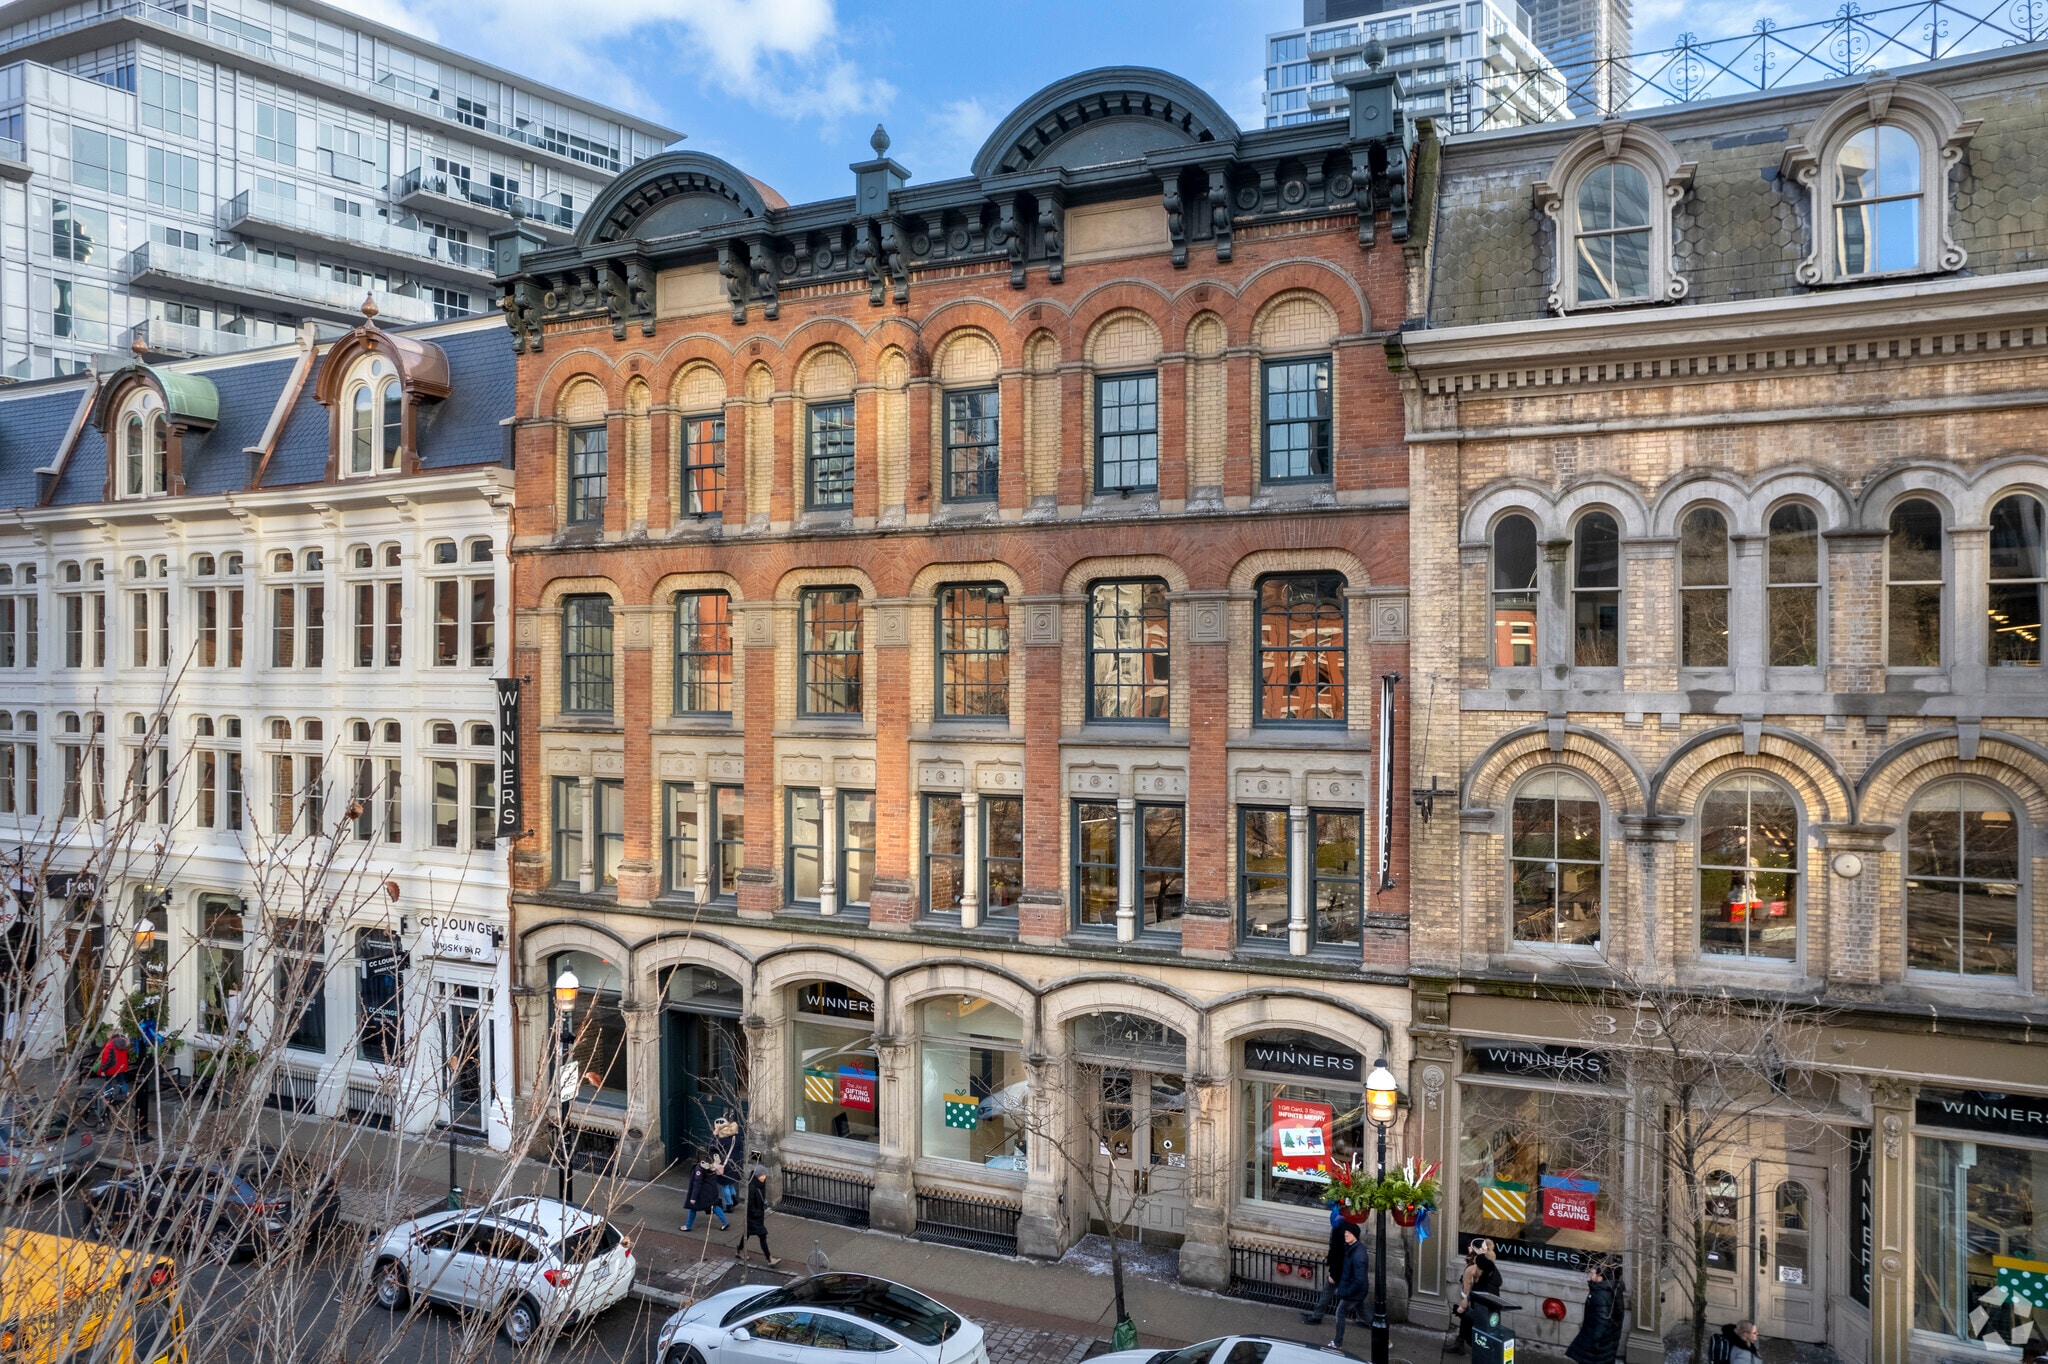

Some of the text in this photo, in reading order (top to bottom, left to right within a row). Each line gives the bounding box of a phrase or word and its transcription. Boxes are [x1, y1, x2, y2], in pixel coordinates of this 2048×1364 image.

[499, 690, 518, 825] WINNERS
[420, 917, 493, 937] CC LOUNGE
[432, 942, 481, 956] WHISKY BAR
[369, 960, 378, 968] CC
[705, 980, 718, 990] 43
[1125, 1030, 1139, 1041] 41
[1255, 1048, 1354, 1071] WINNERS
[1488, 1048, 1601, 1072] WINNERS
[845, 1087, 869, 1097] GIFTING
[848, 1093, 870, 1103] SAVING
[1278, 1111, 1326, 1122] INFINITE MERRY
[1942, 1101, 2048, 1124] WINNER
[1553, 1195, 1566, 1204] The
[1567, 1198, 1578, 1206] Joy
[1551, 1202, 1588, 1214] GIFTING
[1549, 1209, 1590, 1222] & SAVING
[1495, 1242, 1580, 1264] WINNERS
